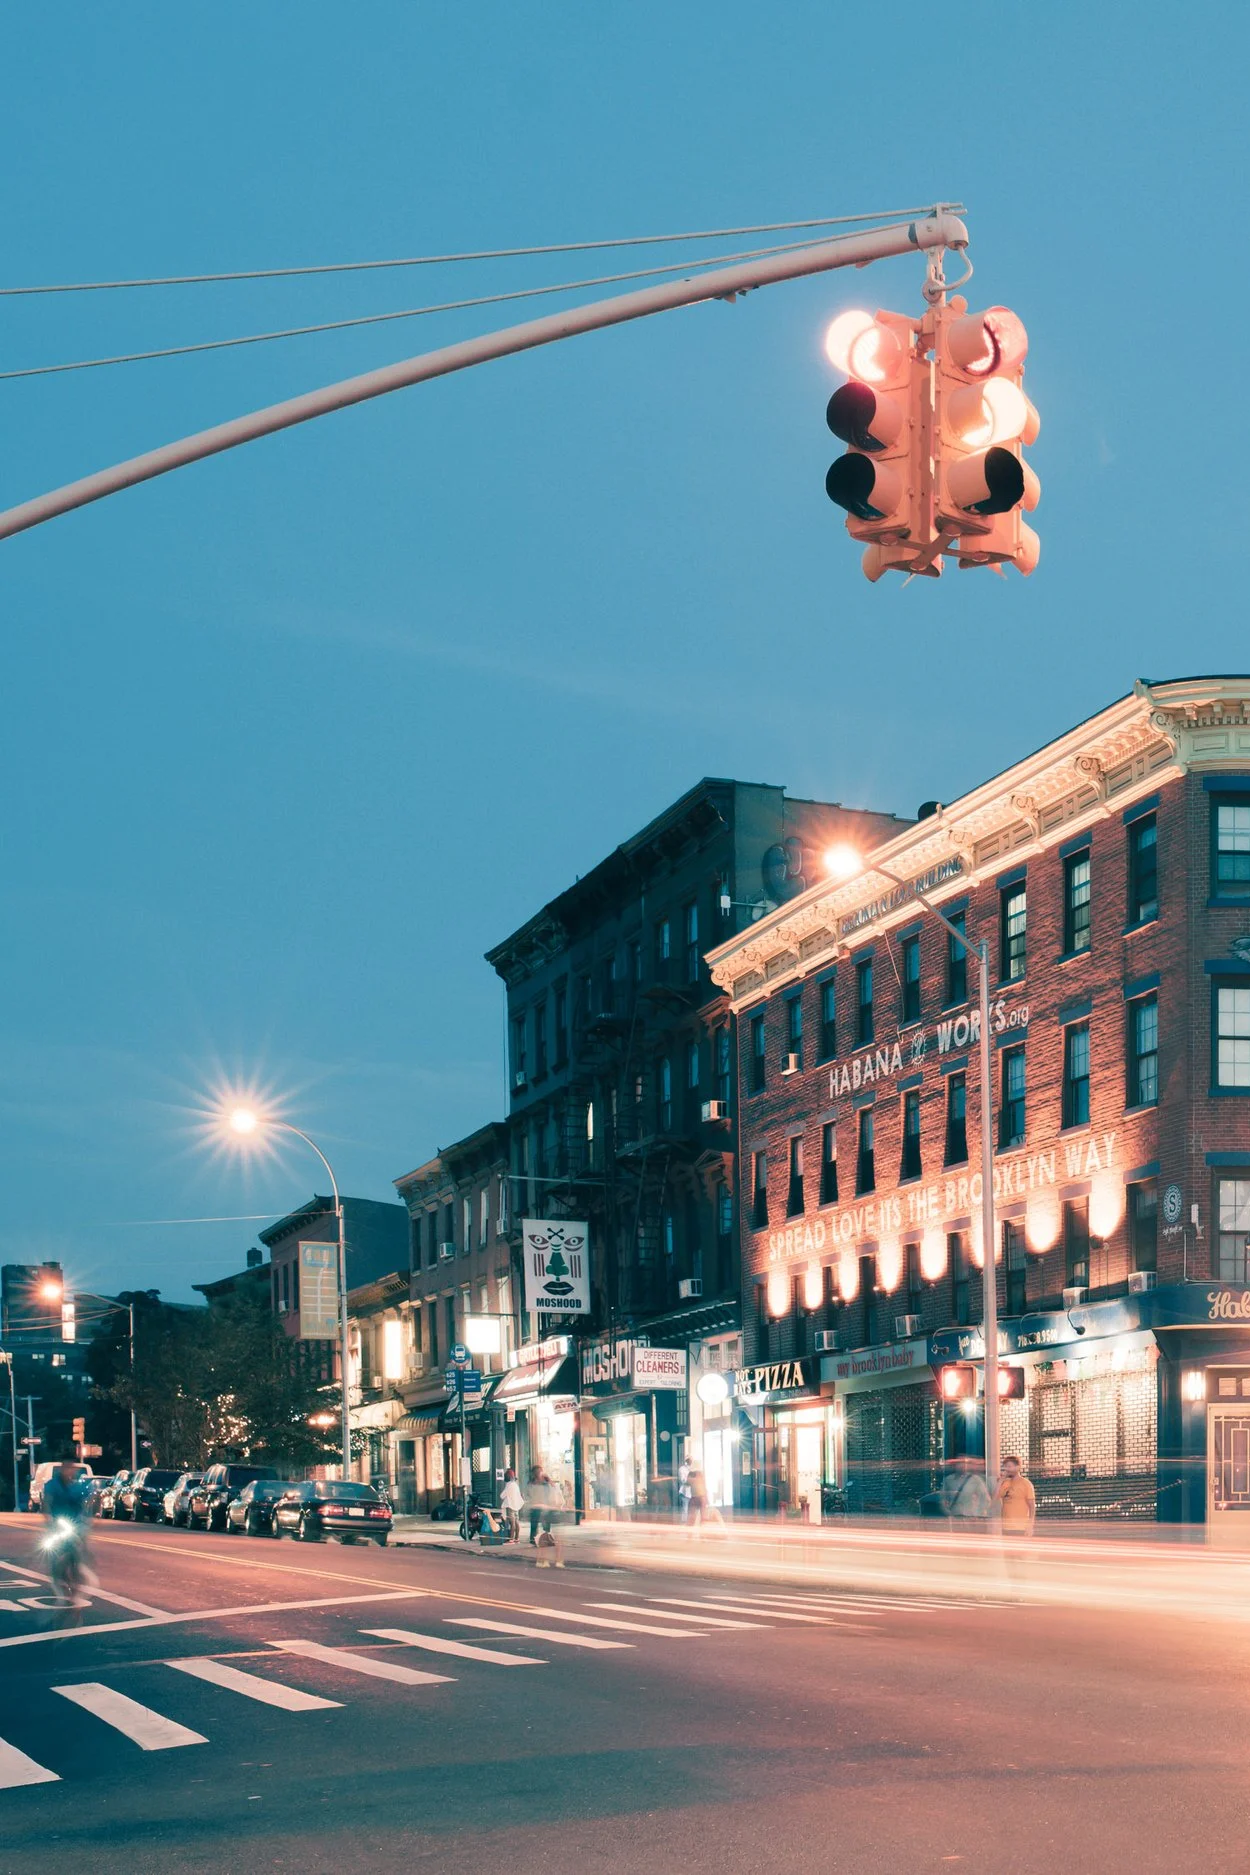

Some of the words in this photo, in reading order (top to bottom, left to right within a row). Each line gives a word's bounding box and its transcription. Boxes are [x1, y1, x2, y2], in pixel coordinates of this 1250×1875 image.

[829, 1043, 903, 1098] HABANA
[769, 1221, 826, 1261] SPREAD
[832, 1204, 876, 1244] LOVE
[907, 1186, 939, 1222] THE
[1064, 1132, 1116, 1177] WAY
[536, 1297, 582, 1309] MOSHOOD
[644, 1351, 678, 1360] DIFFERENT
[636, 1360, 680, 1375] CLEANERS
[755, 1361, 805, 1393] PIZZA
[554, 1401, 577, 1410] ATM
